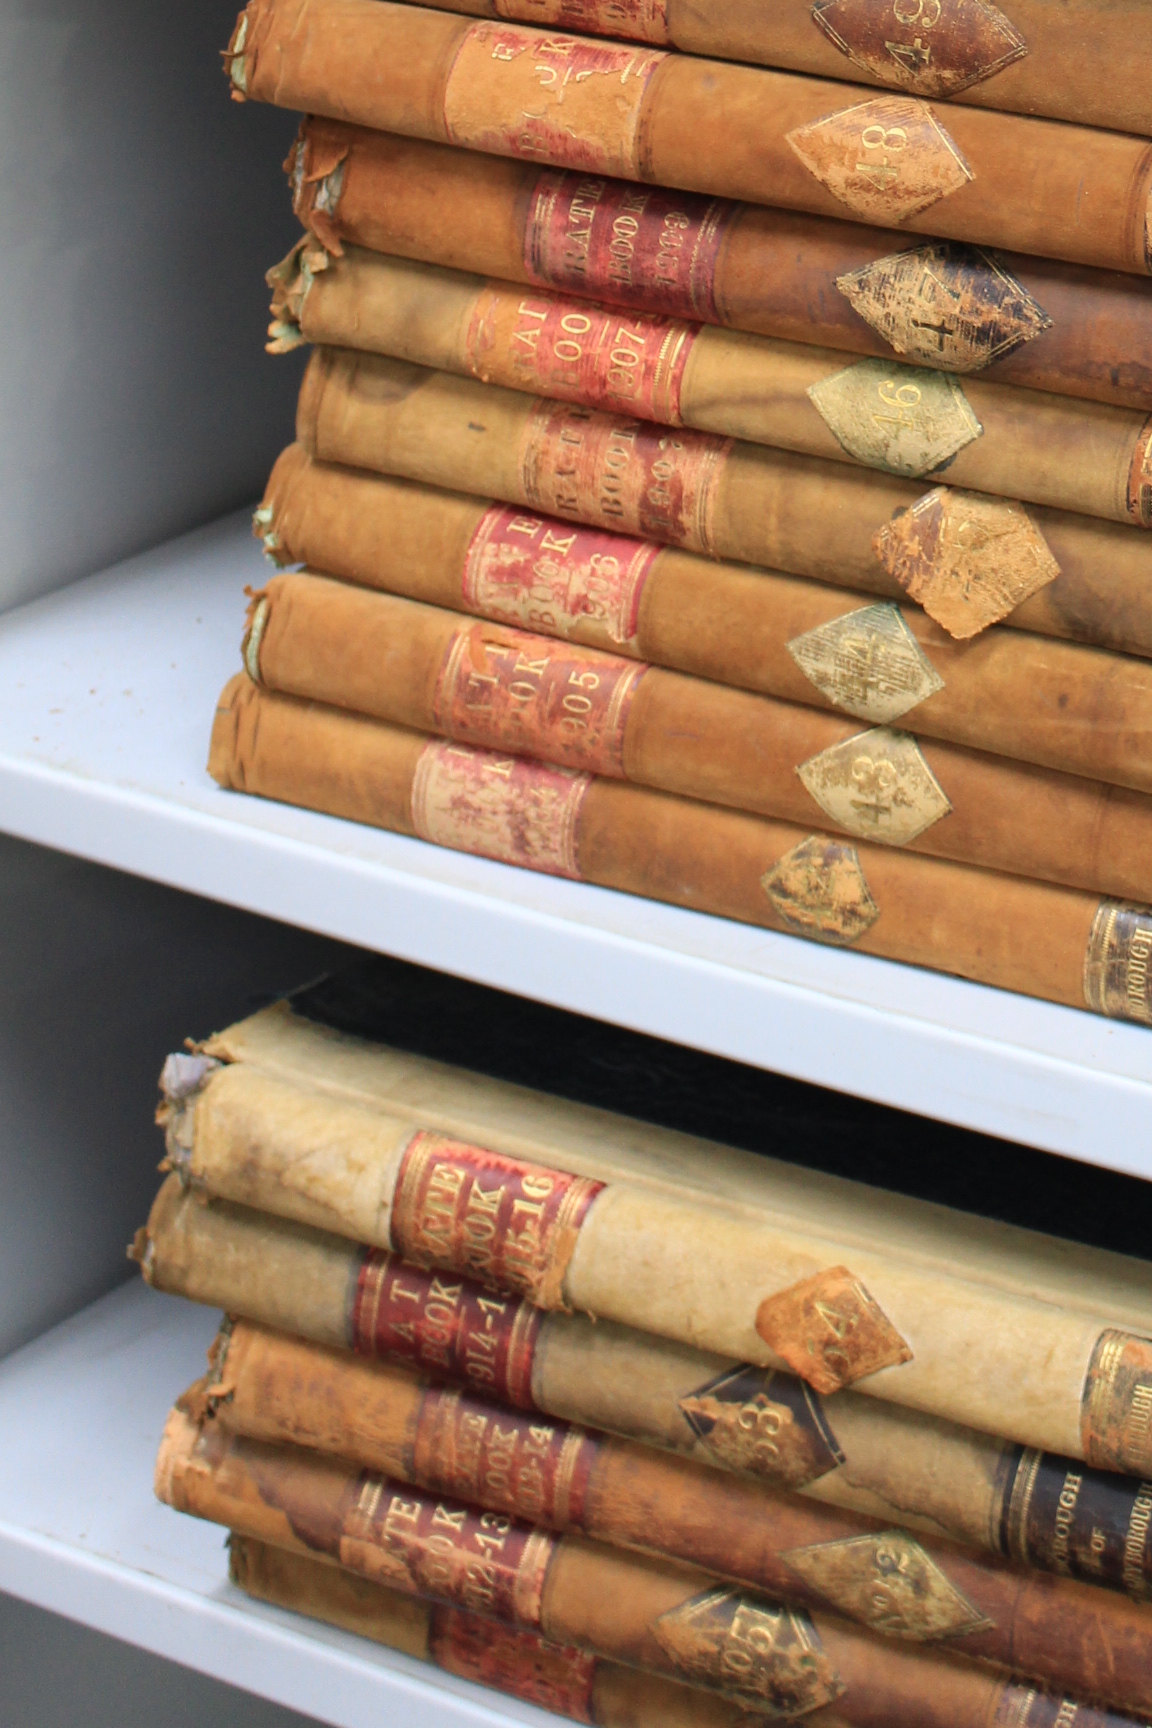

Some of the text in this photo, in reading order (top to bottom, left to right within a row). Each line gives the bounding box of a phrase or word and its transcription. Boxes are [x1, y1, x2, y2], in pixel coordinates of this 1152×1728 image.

[562, 672, 600, 735] 905
[424, 1164, 464, 1249] ATE
[472, 1180, 506, 1262] OOK
[466, 1296, 507, 1381] 914-1
[1053, 1471, 1082, 1566] OROUGH
[1090, 1527, 1106, 1552] OF
